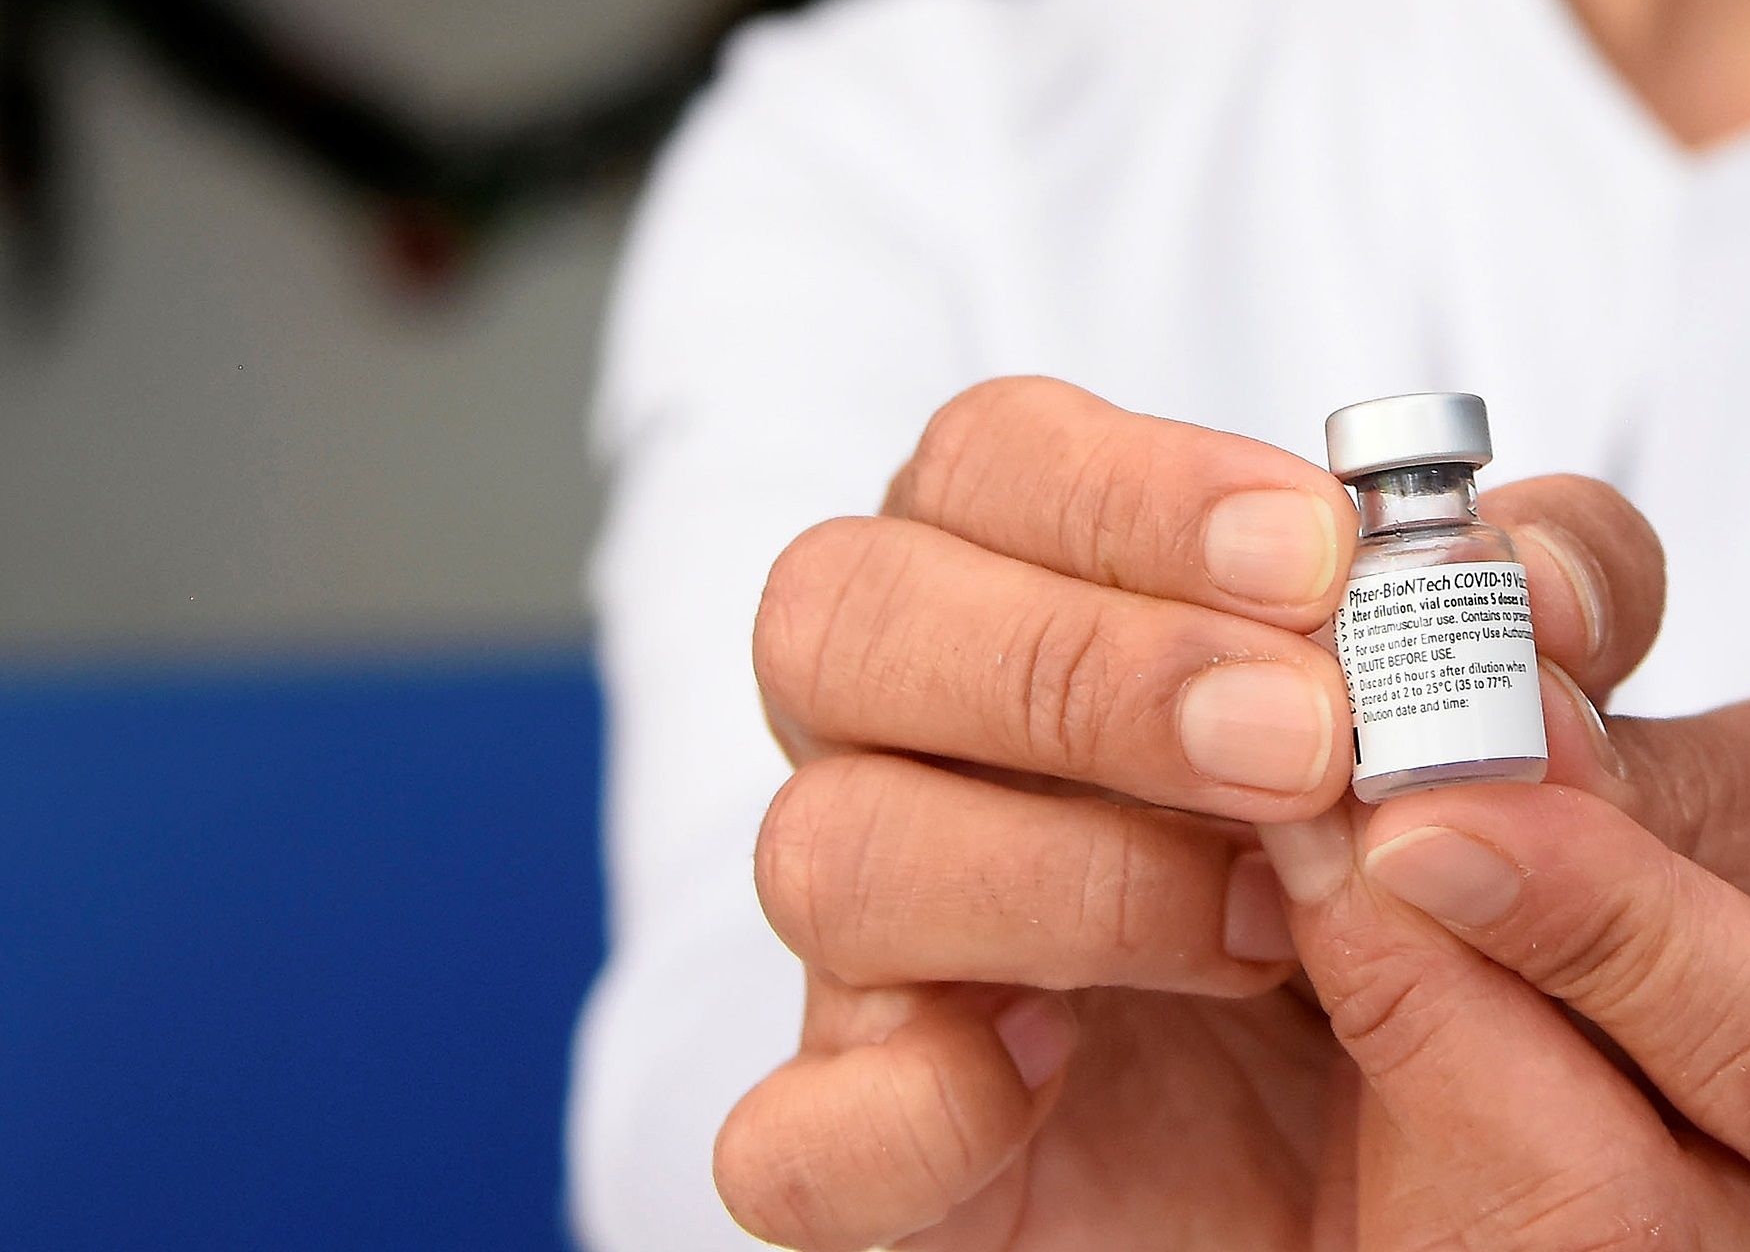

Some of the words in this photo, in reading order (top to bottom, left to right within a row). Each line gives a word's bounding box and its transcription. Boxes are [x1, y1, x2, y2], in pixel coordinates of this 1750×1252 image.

[1349, 574, 1451, 608] Pfizer-BioNTech
[1454, 572, 1512, 589] COVID-19
[1373, 602, 1416, 619] dilution,
[1419, 597, 1440, 610] vial
[1443, 593, 1489, 608] contains
[1490, 592, 1496, 605] 5
[1353, 628, 1364, 640] For
[1367, 616, 1433, 636] intramuscular
[1436, 614, 1459, 626] use.
[1461, 610, 1500, 623] Contains
[1355, 645, 1367, 657] For
[1369, 643, 1385, 654] use
[1387, 637, 1417, 650] under
[1421, 630, 1481, 644] Emergency
[1482, 627, 1500, 639] Use
[1357, 657, 1386, 674] DILUTE
[1388, 650, 1428, 668] BEFORE
[1431, 647, 1456, 661] USE.
[1360, 674, 1393, 691] Discard
[1395, 672, 1402, 684] 6
[1404, 669, 1436, 682] hours
[1439, 665, 1465, 678] after
[1468, 660, 1505, 674] dilution
[1506, 660, 1527, 673] when
[1361, 690, 1388, 706] stored
[1391, 689, 1401, 700] at
[1403, 686, 1410, 698] 2
[1412, 687, 1423, 697] to
[1426, 680, 1452, 695] 25°C
[1455, 678, 1471, 692] (35
[1474, 679, 1485, 689] to
[1363, 707, 1393, 724] Dilution
[1395, 704, 1417, 717] date
[1420, 699, 1440, 713] and
[1443, 698, 1469, 710] time:
